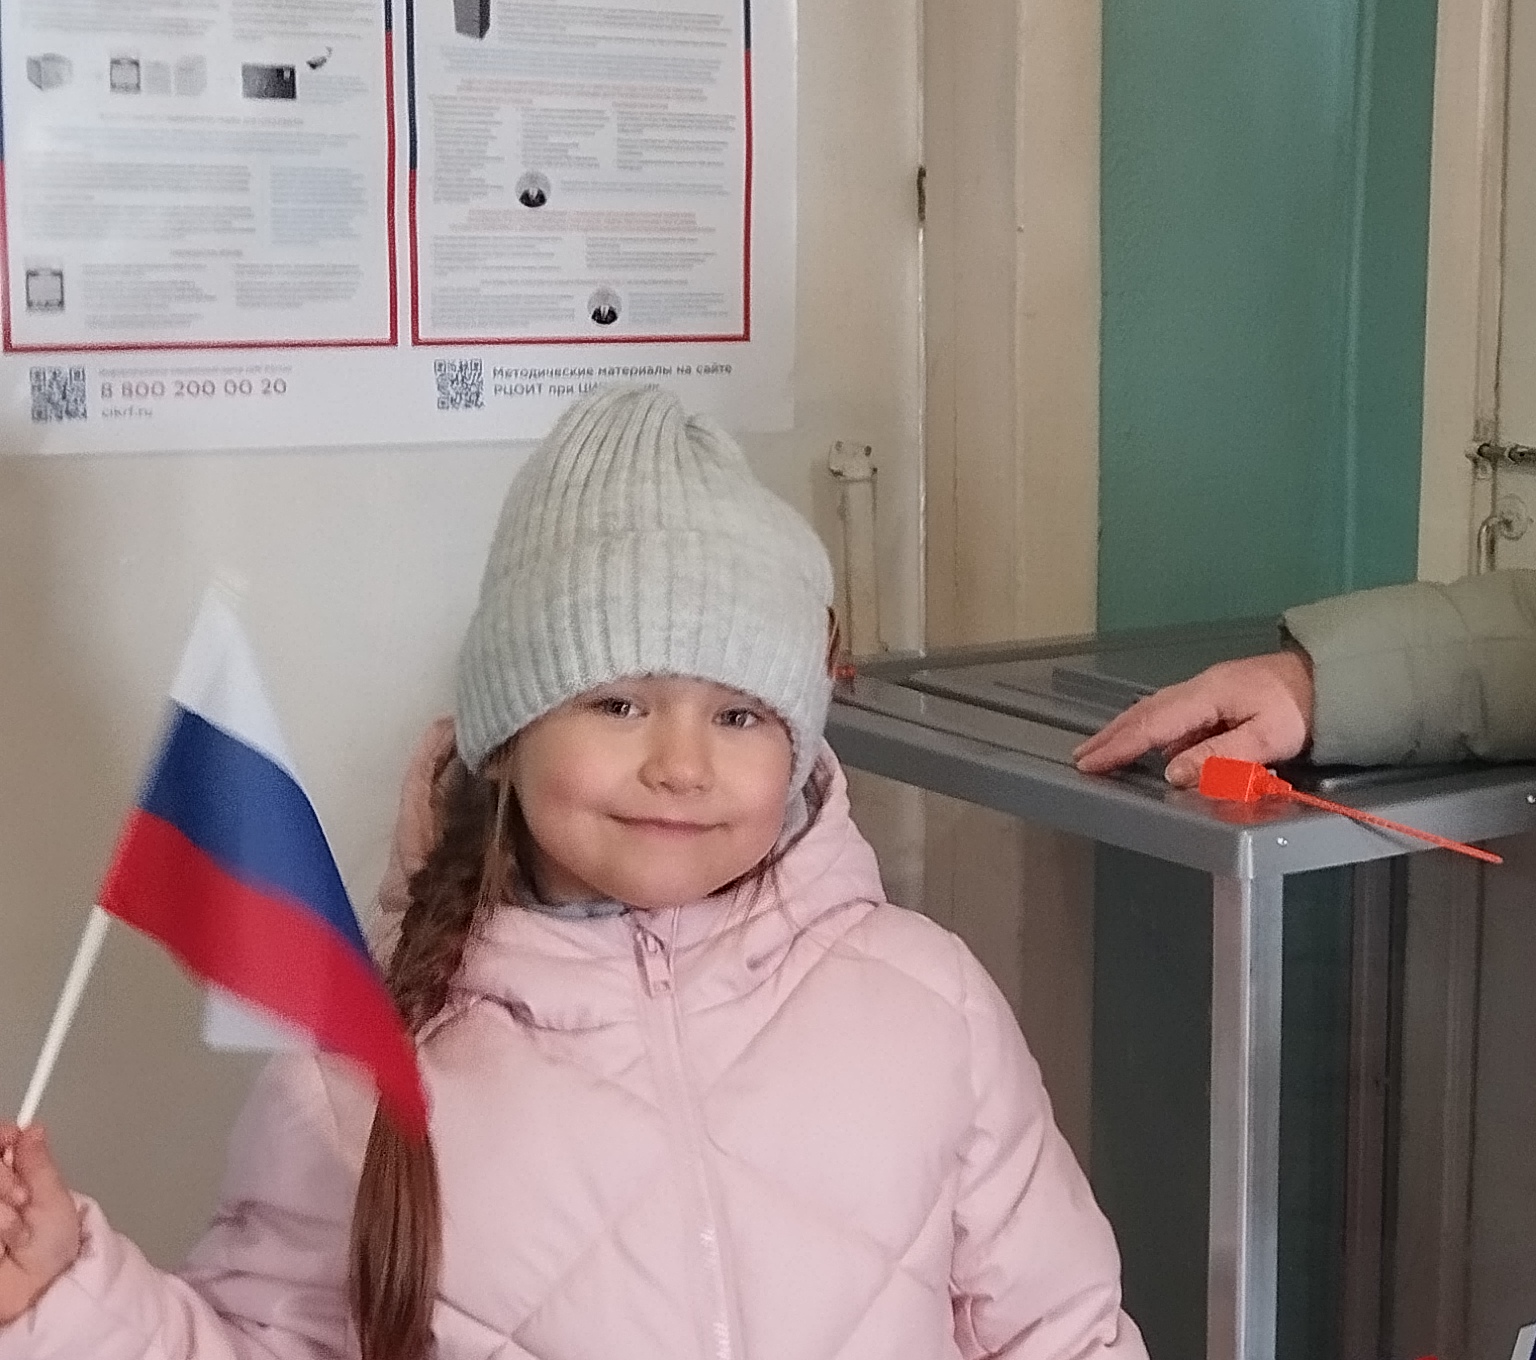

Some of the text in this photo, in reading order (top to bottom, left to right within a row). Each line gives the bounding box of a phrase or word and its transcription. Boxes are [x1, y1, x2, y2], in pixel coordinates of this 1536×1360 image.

[492, 362, 733, 380] Методические материалы на сайте
[101, 378, 288, 400] 8 800 200 00 20
[549, 384, 575, 398] при
